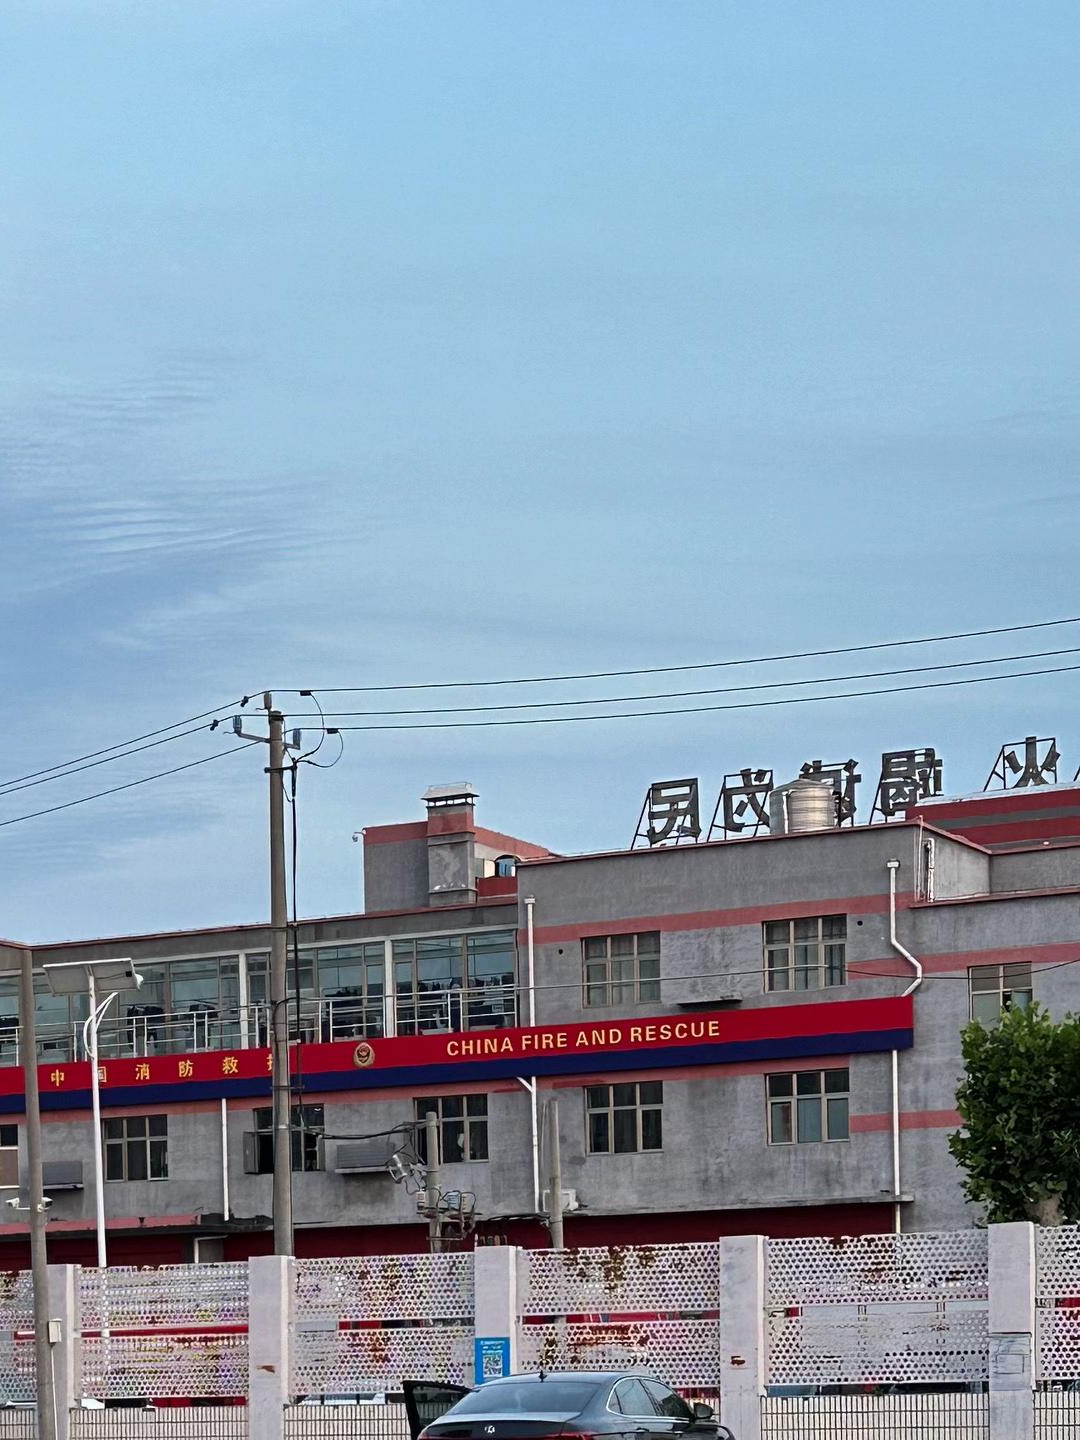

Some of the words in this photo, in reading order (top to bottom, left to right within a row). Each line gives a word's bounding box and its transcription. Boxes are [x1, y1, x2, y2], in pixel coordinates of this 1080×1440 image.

[446, 1037, 514, 1056] CHINA
[521, 1032, 568, 1051] FIRE
[575, 1028, 622, 1047] AND
[630, 1020, 720, 1042] RESCUE
